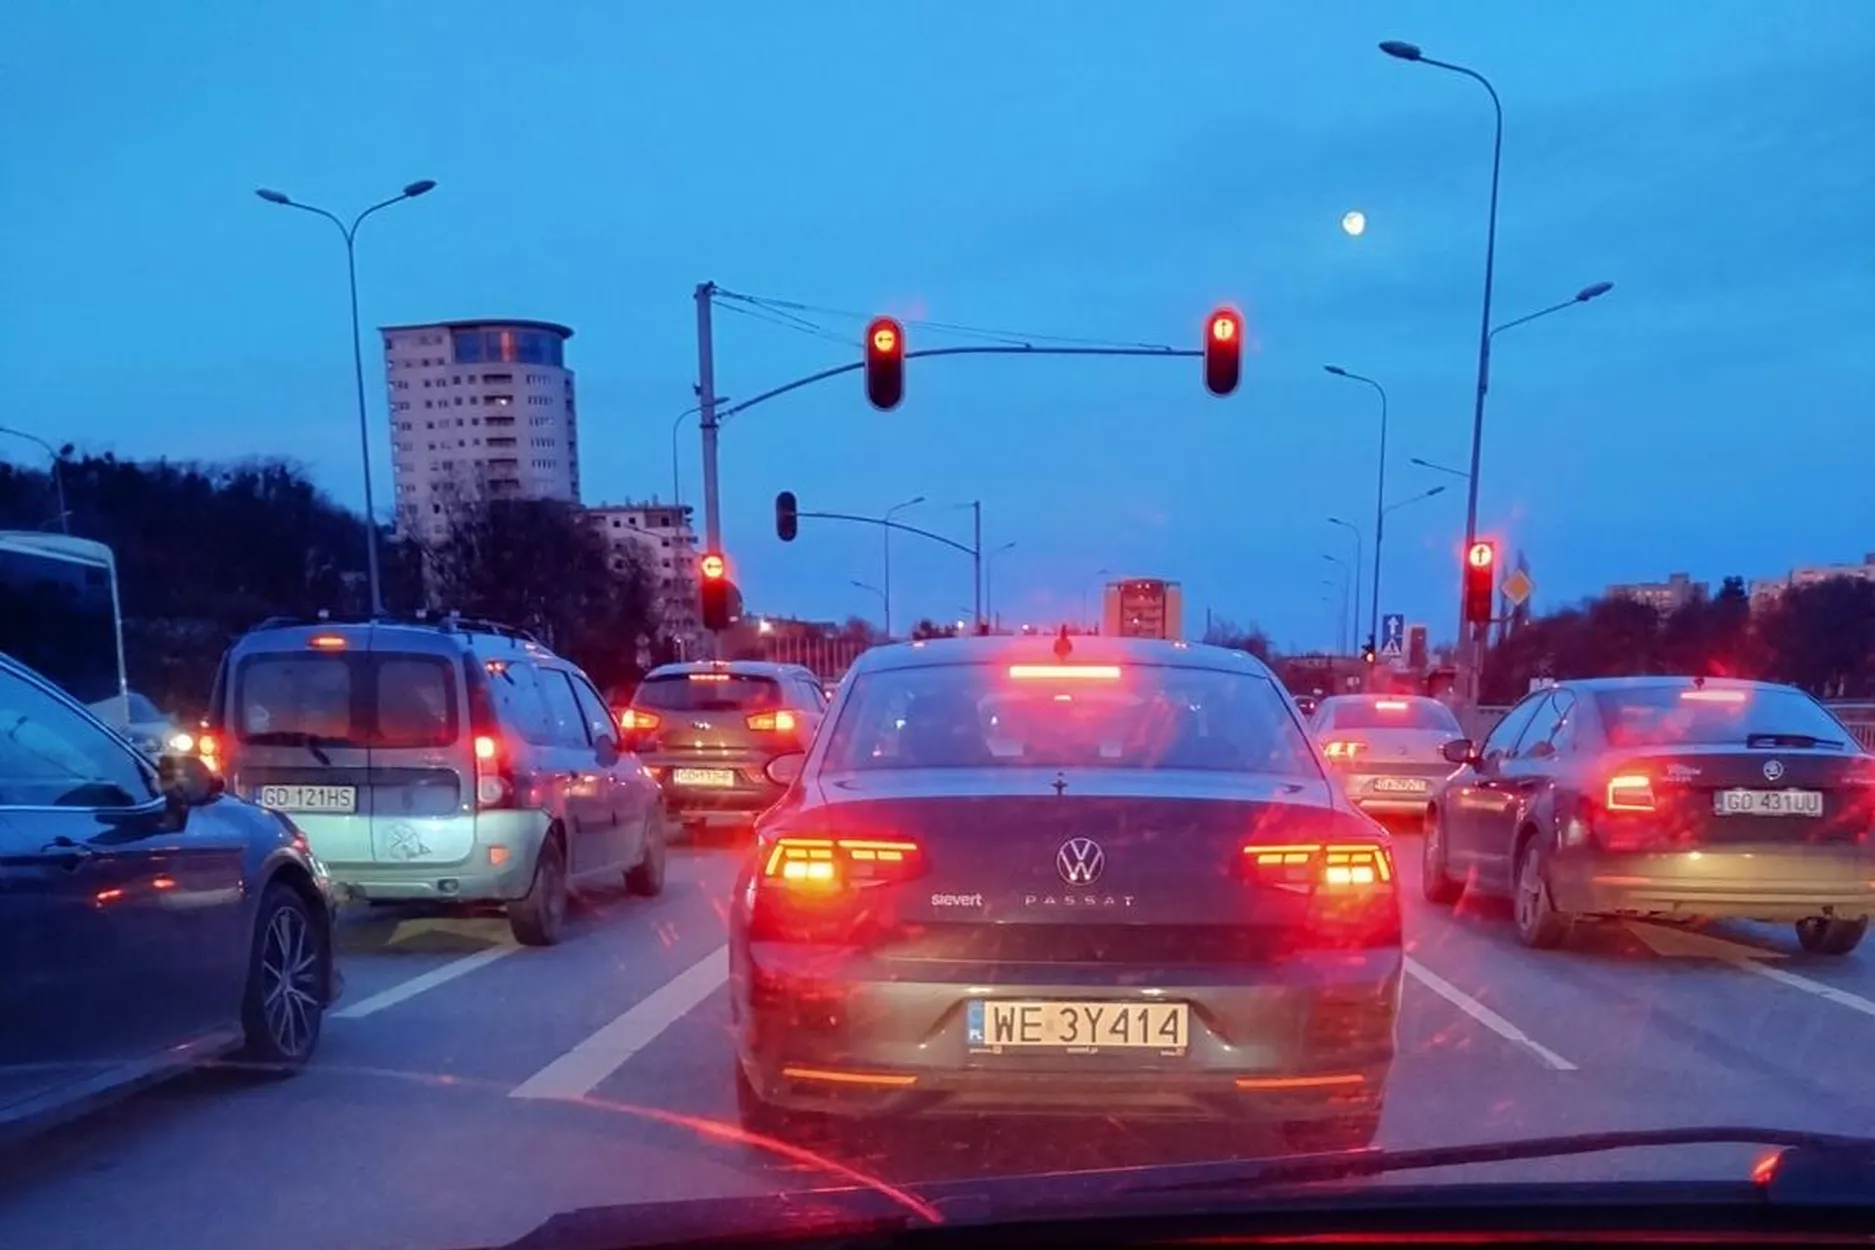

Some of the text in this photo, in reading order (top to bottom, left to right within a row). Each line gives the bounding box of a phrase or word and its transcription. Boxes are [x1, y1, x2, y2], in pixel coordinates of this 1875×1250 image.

[263, 788, 351, 806] GD 121HS
[1728, 792, 1818, 812] GD 431UU
[931, 893, 983, 907] sievert
[1025, 895, 1134, 906] PASSAT
[994, 1007, 1179, 1044] WE 3Y414
